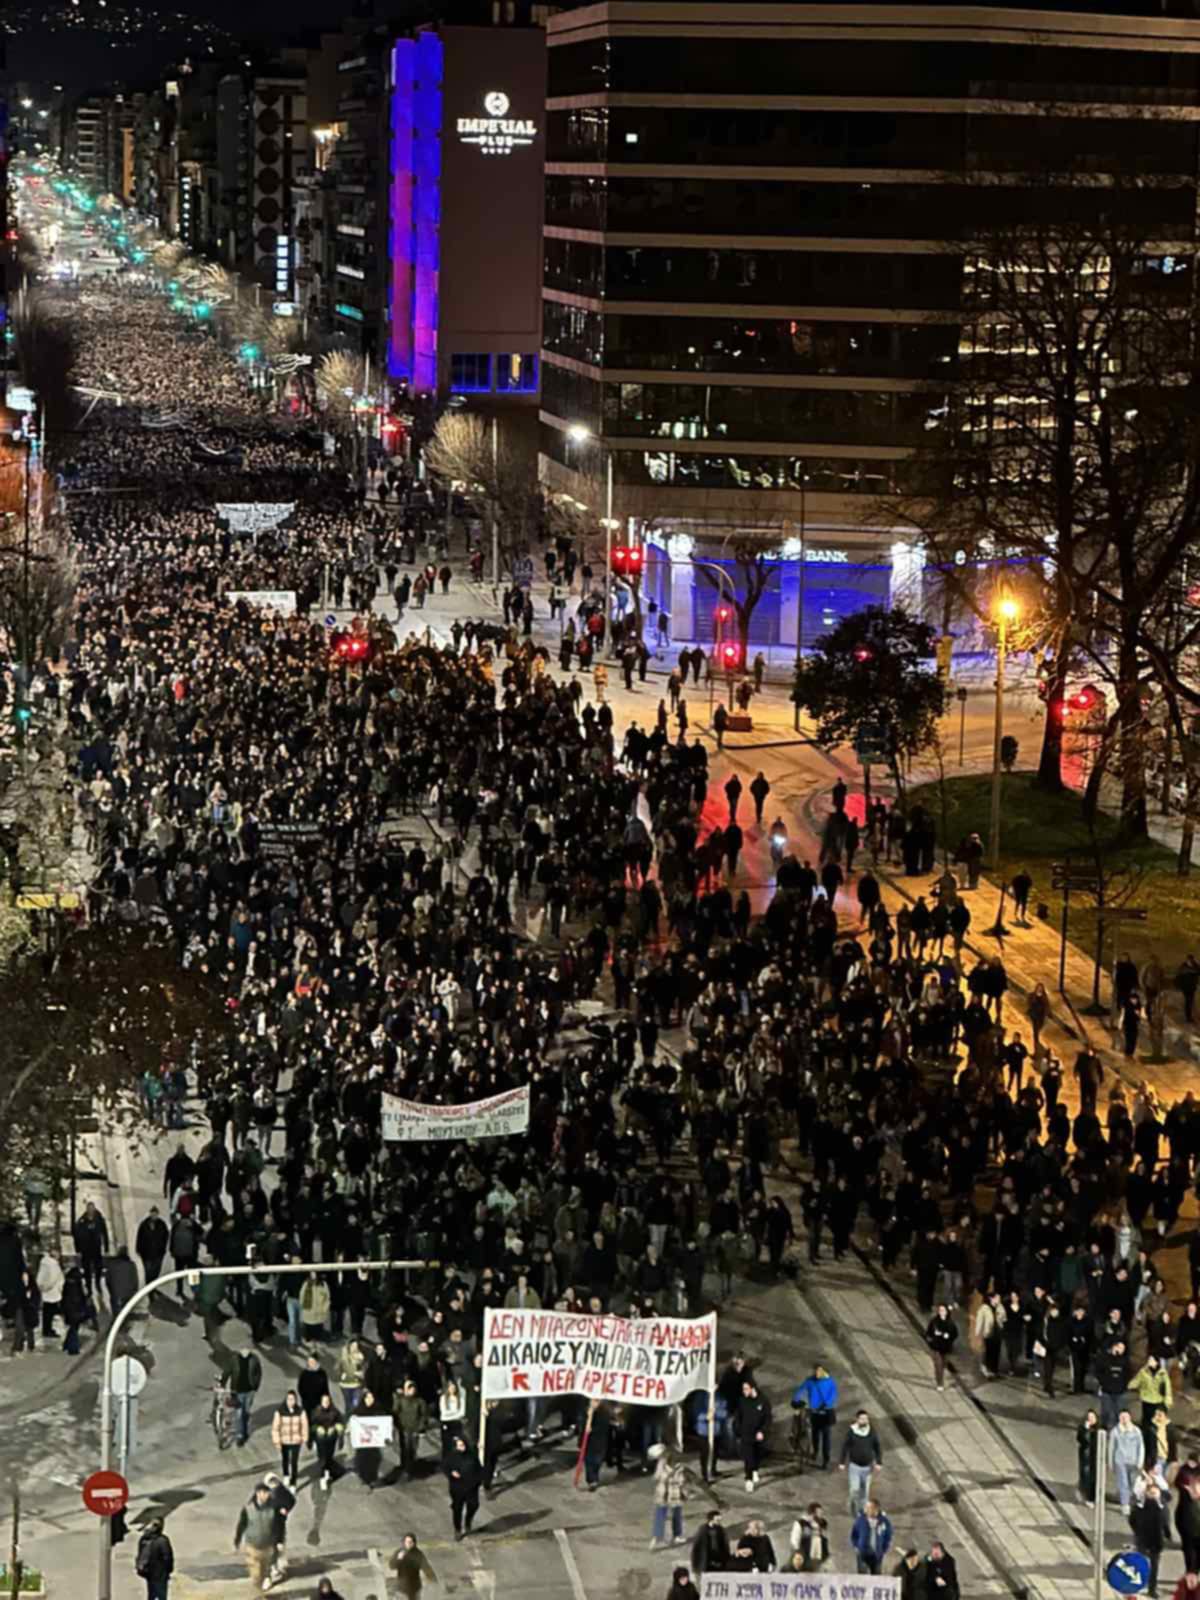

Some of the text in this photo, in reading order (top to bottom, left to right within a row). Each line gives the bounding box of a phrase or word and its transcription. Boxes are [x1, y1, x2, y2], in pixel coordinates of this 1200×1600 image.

[457, 118, 537, 135] IMPERIAL
[805, 550, 849, 562] BANK
[489, 1314, 525, 1339] ΔΕΝ
[488, 1341, 608, 1369] ΔΙΚΑΙΟΣΥΝΗ
[542, 1368, 668, 1399] ΝΕΑ ΑΡΙΣΤΕΡΑ
[705, 1582, 729, 1598] ΣΤΗ
[770, 1582, 789, 1598] ΤΟΥ
